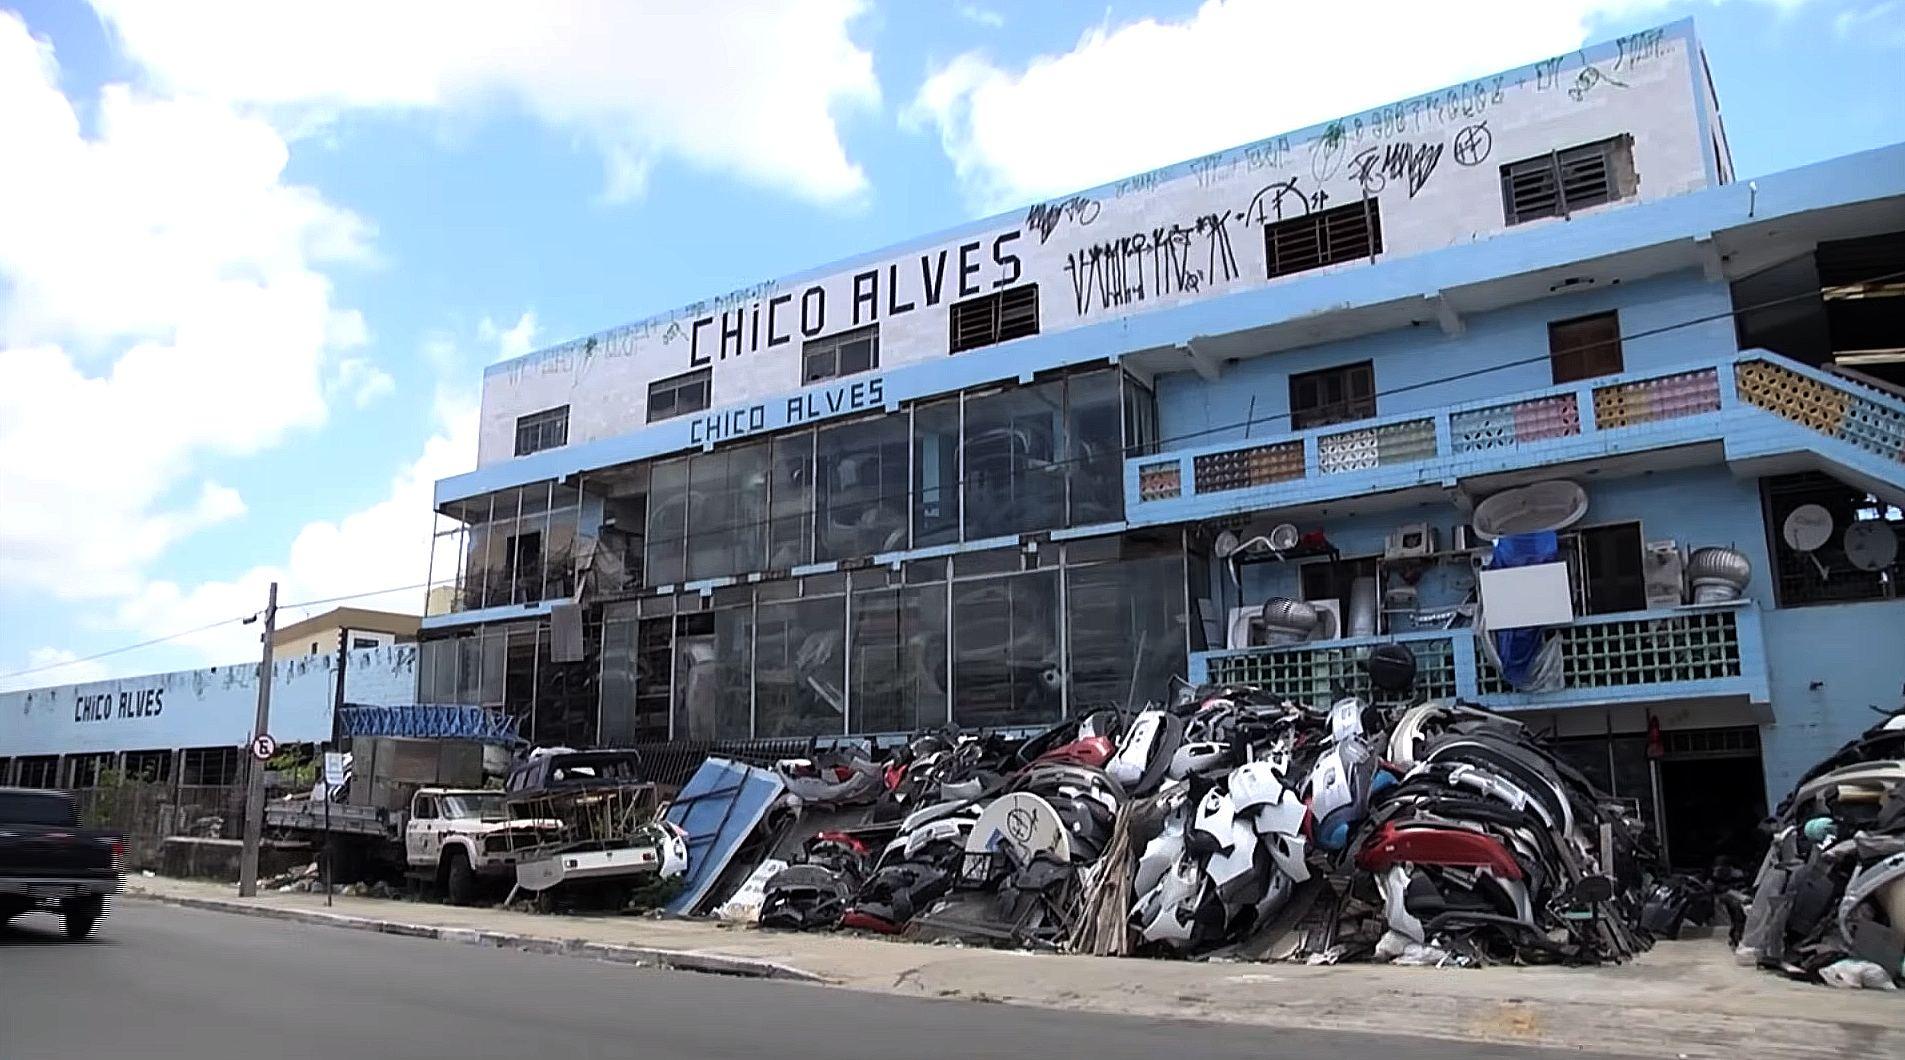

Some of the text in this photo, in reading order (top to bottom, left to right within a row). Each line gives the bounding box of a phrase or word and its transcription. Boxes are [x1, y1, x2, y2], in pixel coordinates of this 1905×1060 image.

[852, 230, 1021, 325] ALVES
[690, 378, 884, 445] CHICO ALVES
[118, 688, 164, 719] ALVES
